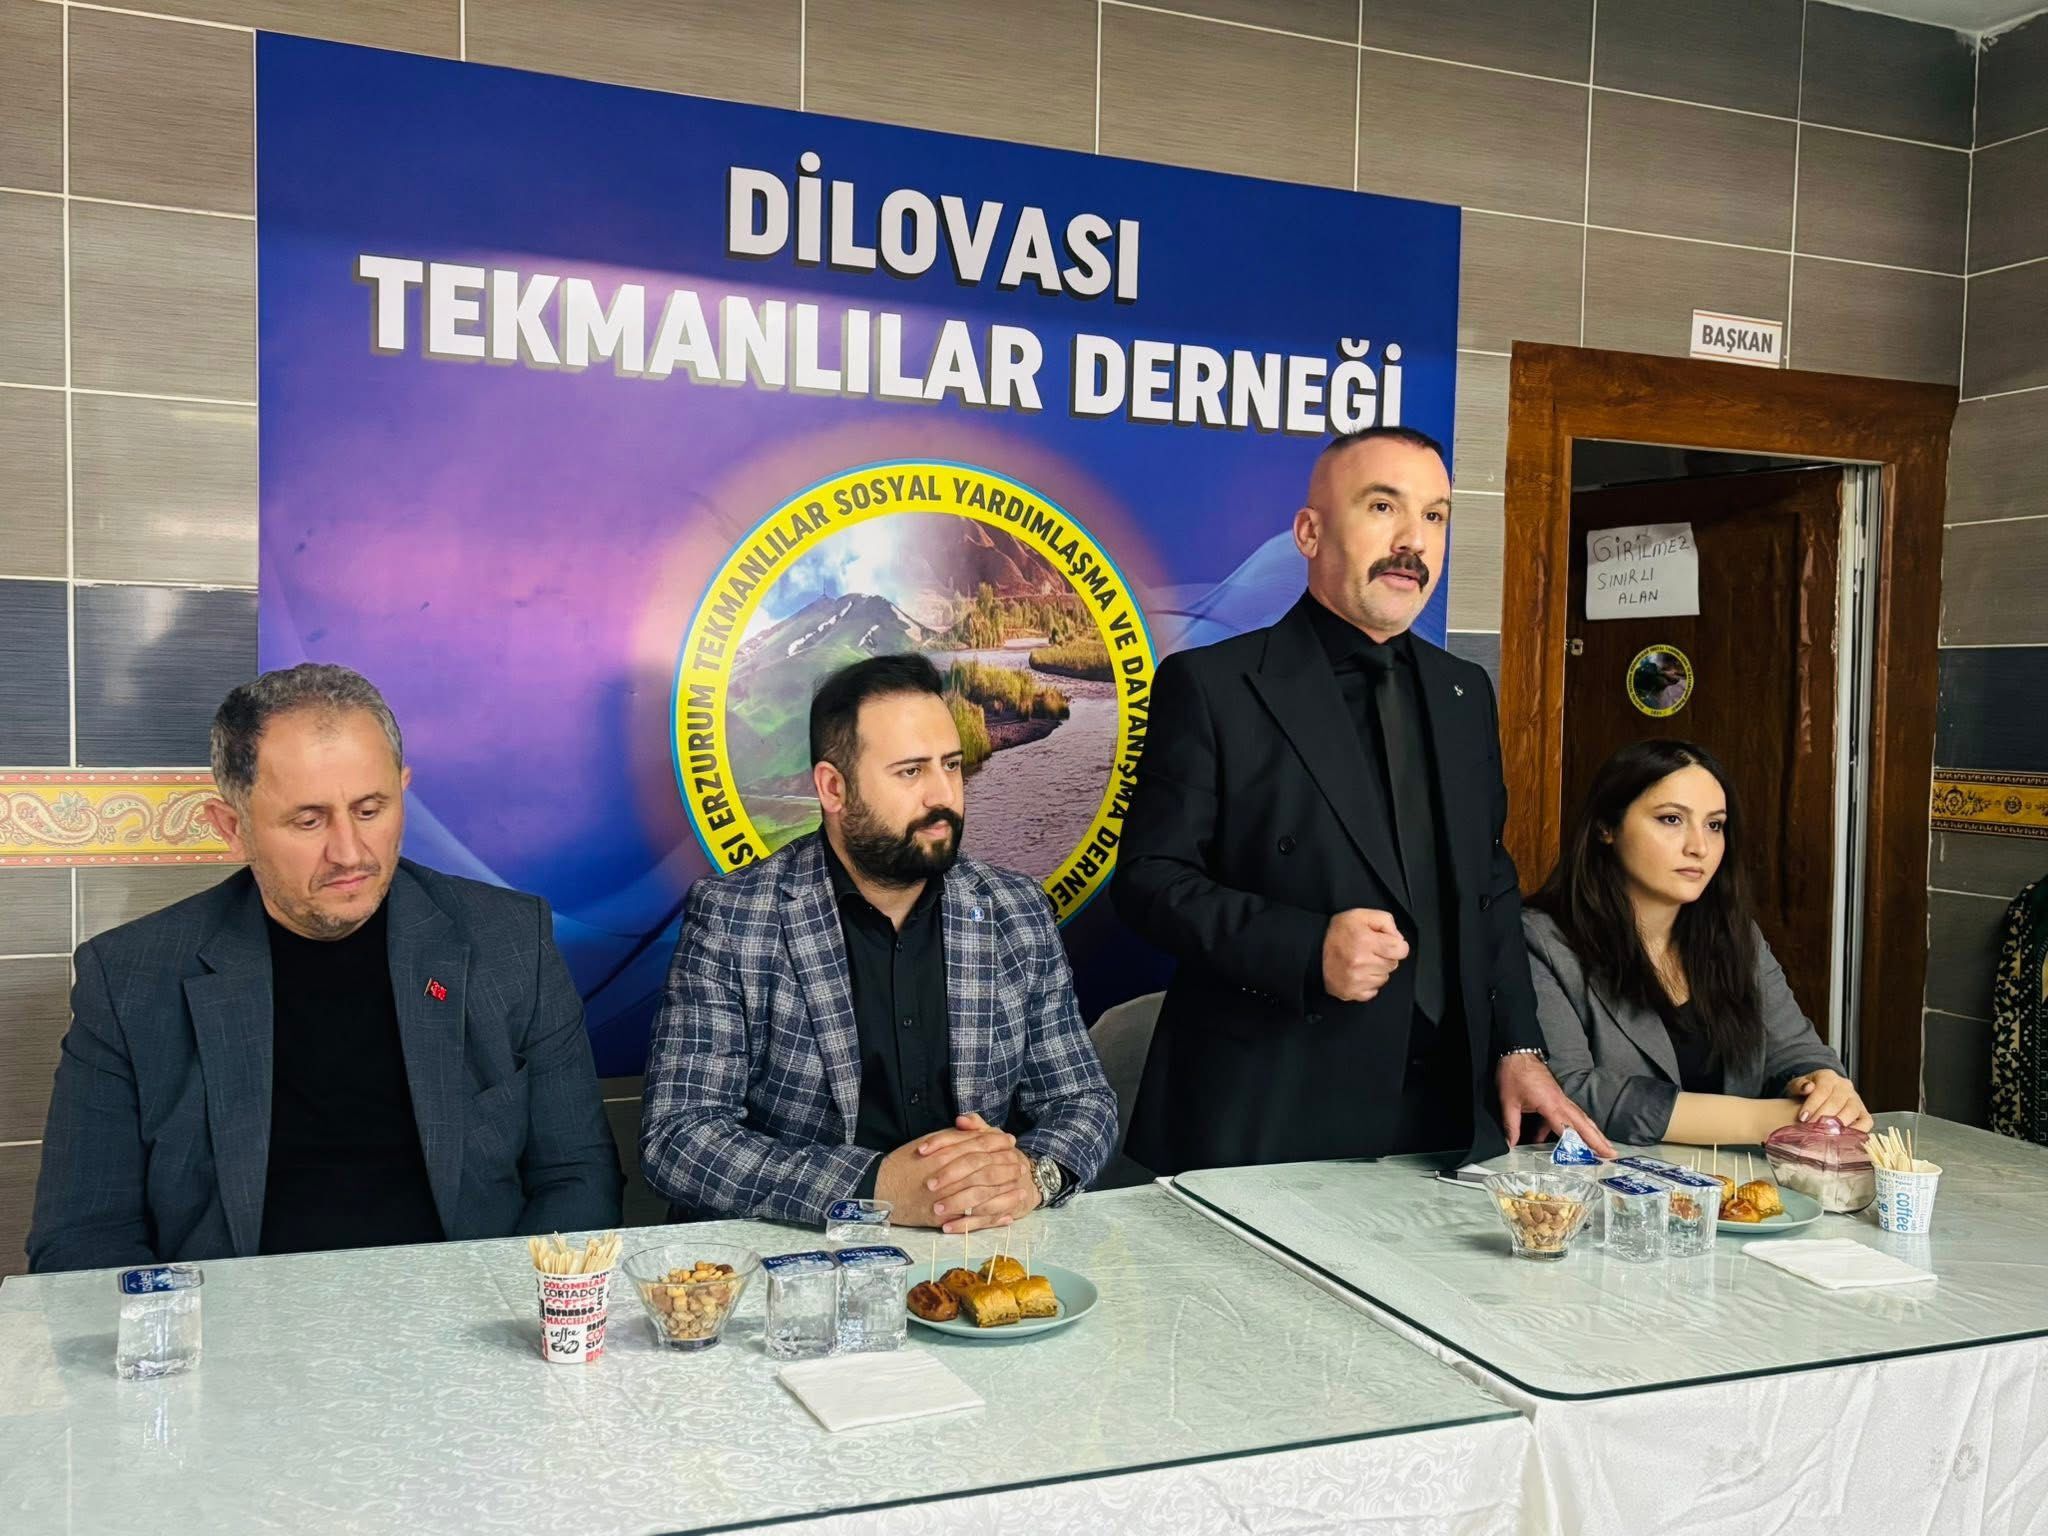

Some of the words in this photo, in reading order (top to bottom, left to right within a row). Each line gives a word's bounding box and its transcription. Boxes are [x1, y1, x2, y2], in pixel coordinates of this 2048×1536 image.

[727, 150, 1141, 302] DİLOVASI
[356, 253, 1044, 411] TEKMANLILAR
[1073, 333, 1402, 436] DERNEĞİ
[1701, 324, 1774, 354] BAŞKAN
[833, 474, 942, 516] SOSYAL
[952, 477, 1118, 612] YARDIMLAŞMA
[692, 500, 832, 672] TEKMANLILAR
[1597, 567, 1655, 590] SINIRLI
[1618, 588, 1660, 605] ALAN
[1108, 609, 1139, 652] VE
[686, 683, 737, 832] ERZURUM
[1896, 1192, 1913, 1232] coffee
[543, 1278, 606, 1290] COLOMBIAN
[543, 1287, 598, 1299] CORTADO
